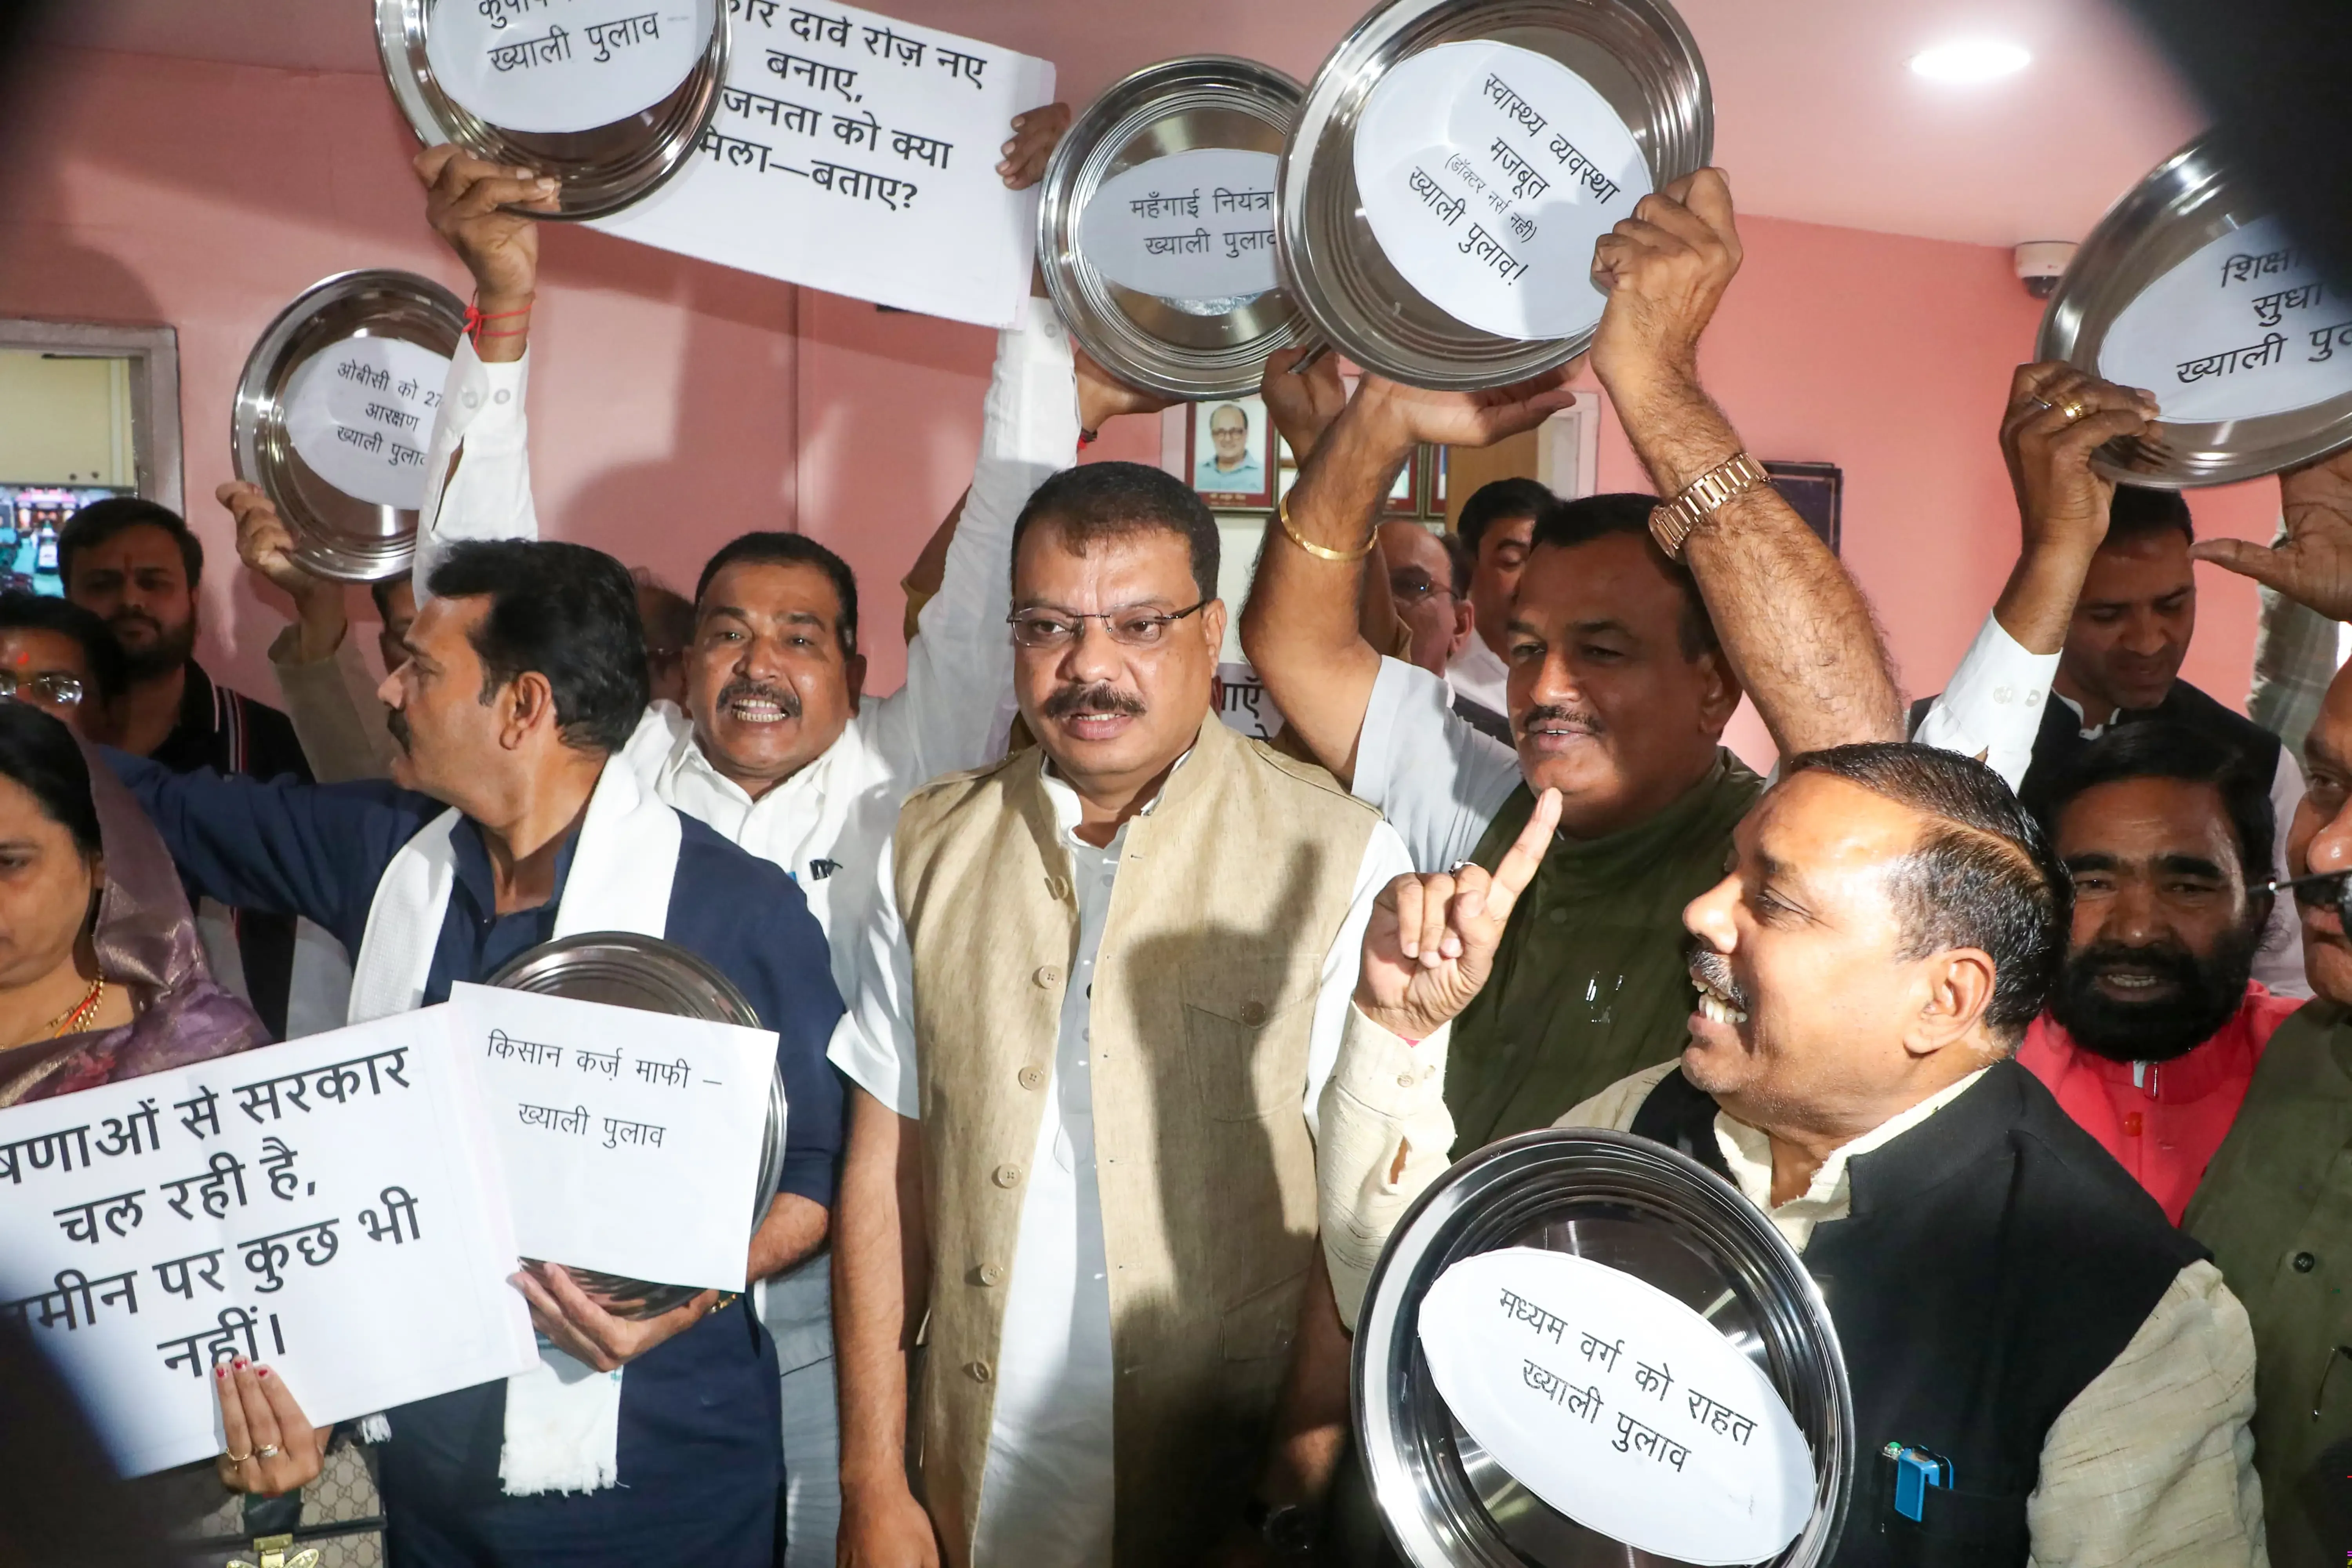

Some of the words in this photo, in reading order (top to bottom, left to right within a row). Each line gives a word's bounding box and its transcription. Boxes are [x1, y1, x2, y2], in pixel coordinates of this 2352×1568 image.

[487, 25, 569, 72] ख्याली
[585, 13, 659, 62] पुलाव
[789, 8, 853, 47] दावे
[936, 48, 987, 89] नए
[766, 49, 862, 103] बनाए,
[723, 86, 822, 137] जनता
[833, 111, 881, 151] को
[891, 130, 953, 169] क्या
[1484, 73, 1548, 137] स्वास्थ्य
[1550, 133, 1620, 204] व्यवस्था
[1490, 137, 1550, 199] मजबूत
[1130, 188, 1200, 218] महँगाई
[1212, 187, 1274, 213] नियंत्र
[1409, 166, 1466, 227] ख्याली
[1458, 222, 1529, 286] पुलाव!
[1144, 227, 1210, 254] ख्याली
[2252, 284, 2323, 327] सुधा
[338, 358, 390, 391] ओबीसी
[398, 378, 419, 401] को
[2176, 333, 2288, 383] ख्याली
[337, 426, 383, 454] ख्याली
[365, 403, 420, 432] आरक्षण
[487, 1029, 563, 1068] किसान
[576, 1048, 623, 1081] कर्ज़
[636, 1058, 691, 1088] माफी
[173, 1085, 221, 1141] से
[232, 1045, 410, 1124] सरकार
[518, 1103, 591, 1135] ख्याली
[603, 1117, 666, 1149] पुलाव
[53, 1189, 146, 1245] चल
[160, 1152, 246, 1221] रही
[260, 1136, 316, 1202] है,
[152, 1247, 225, 1301] पर
[237, 1217, 340, 1294] कुछ
[358, 1186, 421, 1245] भी
[1499, 1287, 1568, 1344] मध्यम
[1580, 1331, 1625, 1373] वर्ग
[1635, 1360, 1675, 1402] को
[1687, 1388, 1758, 1446] राहत
[1523, 1359, 1604, 1424] ख्याली
[1611, 1411, 1692, 1473] पुलाव
